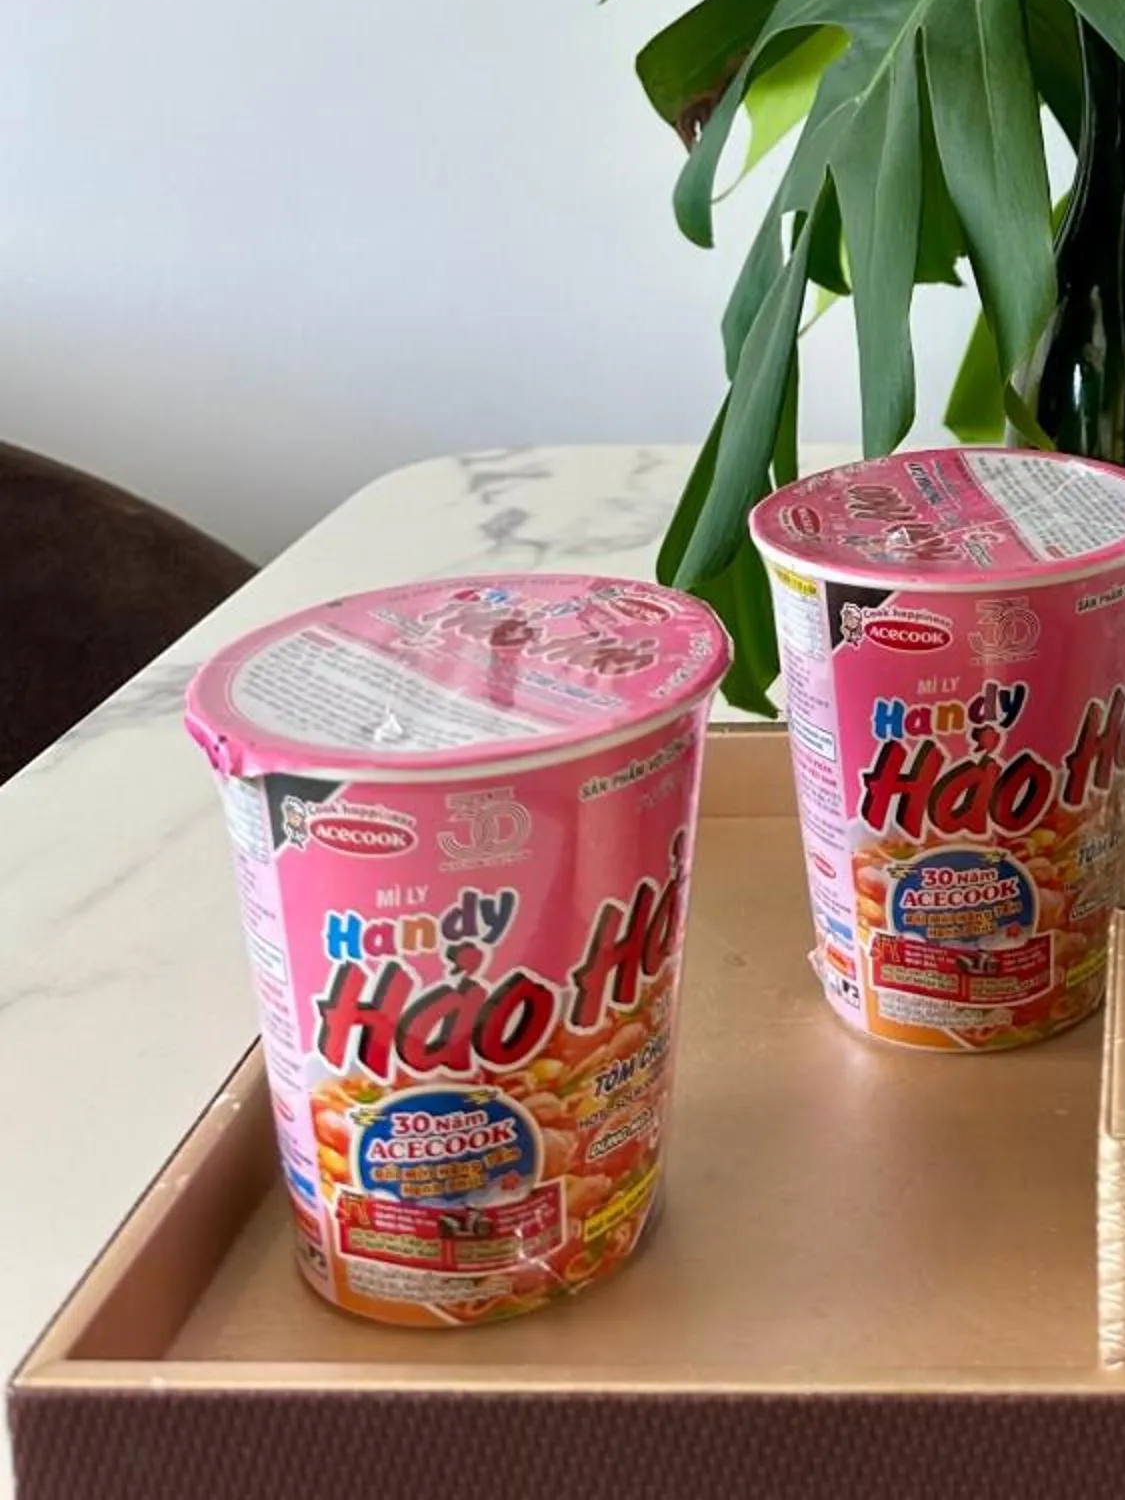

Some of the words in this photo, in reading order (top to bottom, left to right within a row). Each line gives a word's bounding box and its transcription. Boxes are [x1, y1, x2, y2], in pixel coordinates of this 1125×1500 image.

[872, 680, 1028, 740] Handy
[861, 725, 1053, 840] Hảo
[407, 884, 430, 906] LY
[900, 878, 1020, 908] ACECOOK
[921, 868, 954, 888] 30
[324, 887, 519, 963] Handy
[315, 942, 560, 1081] Hảo
[367, 1118, 517, 1162] ACECOOK
[390, 1111, 431, 1136] 30
